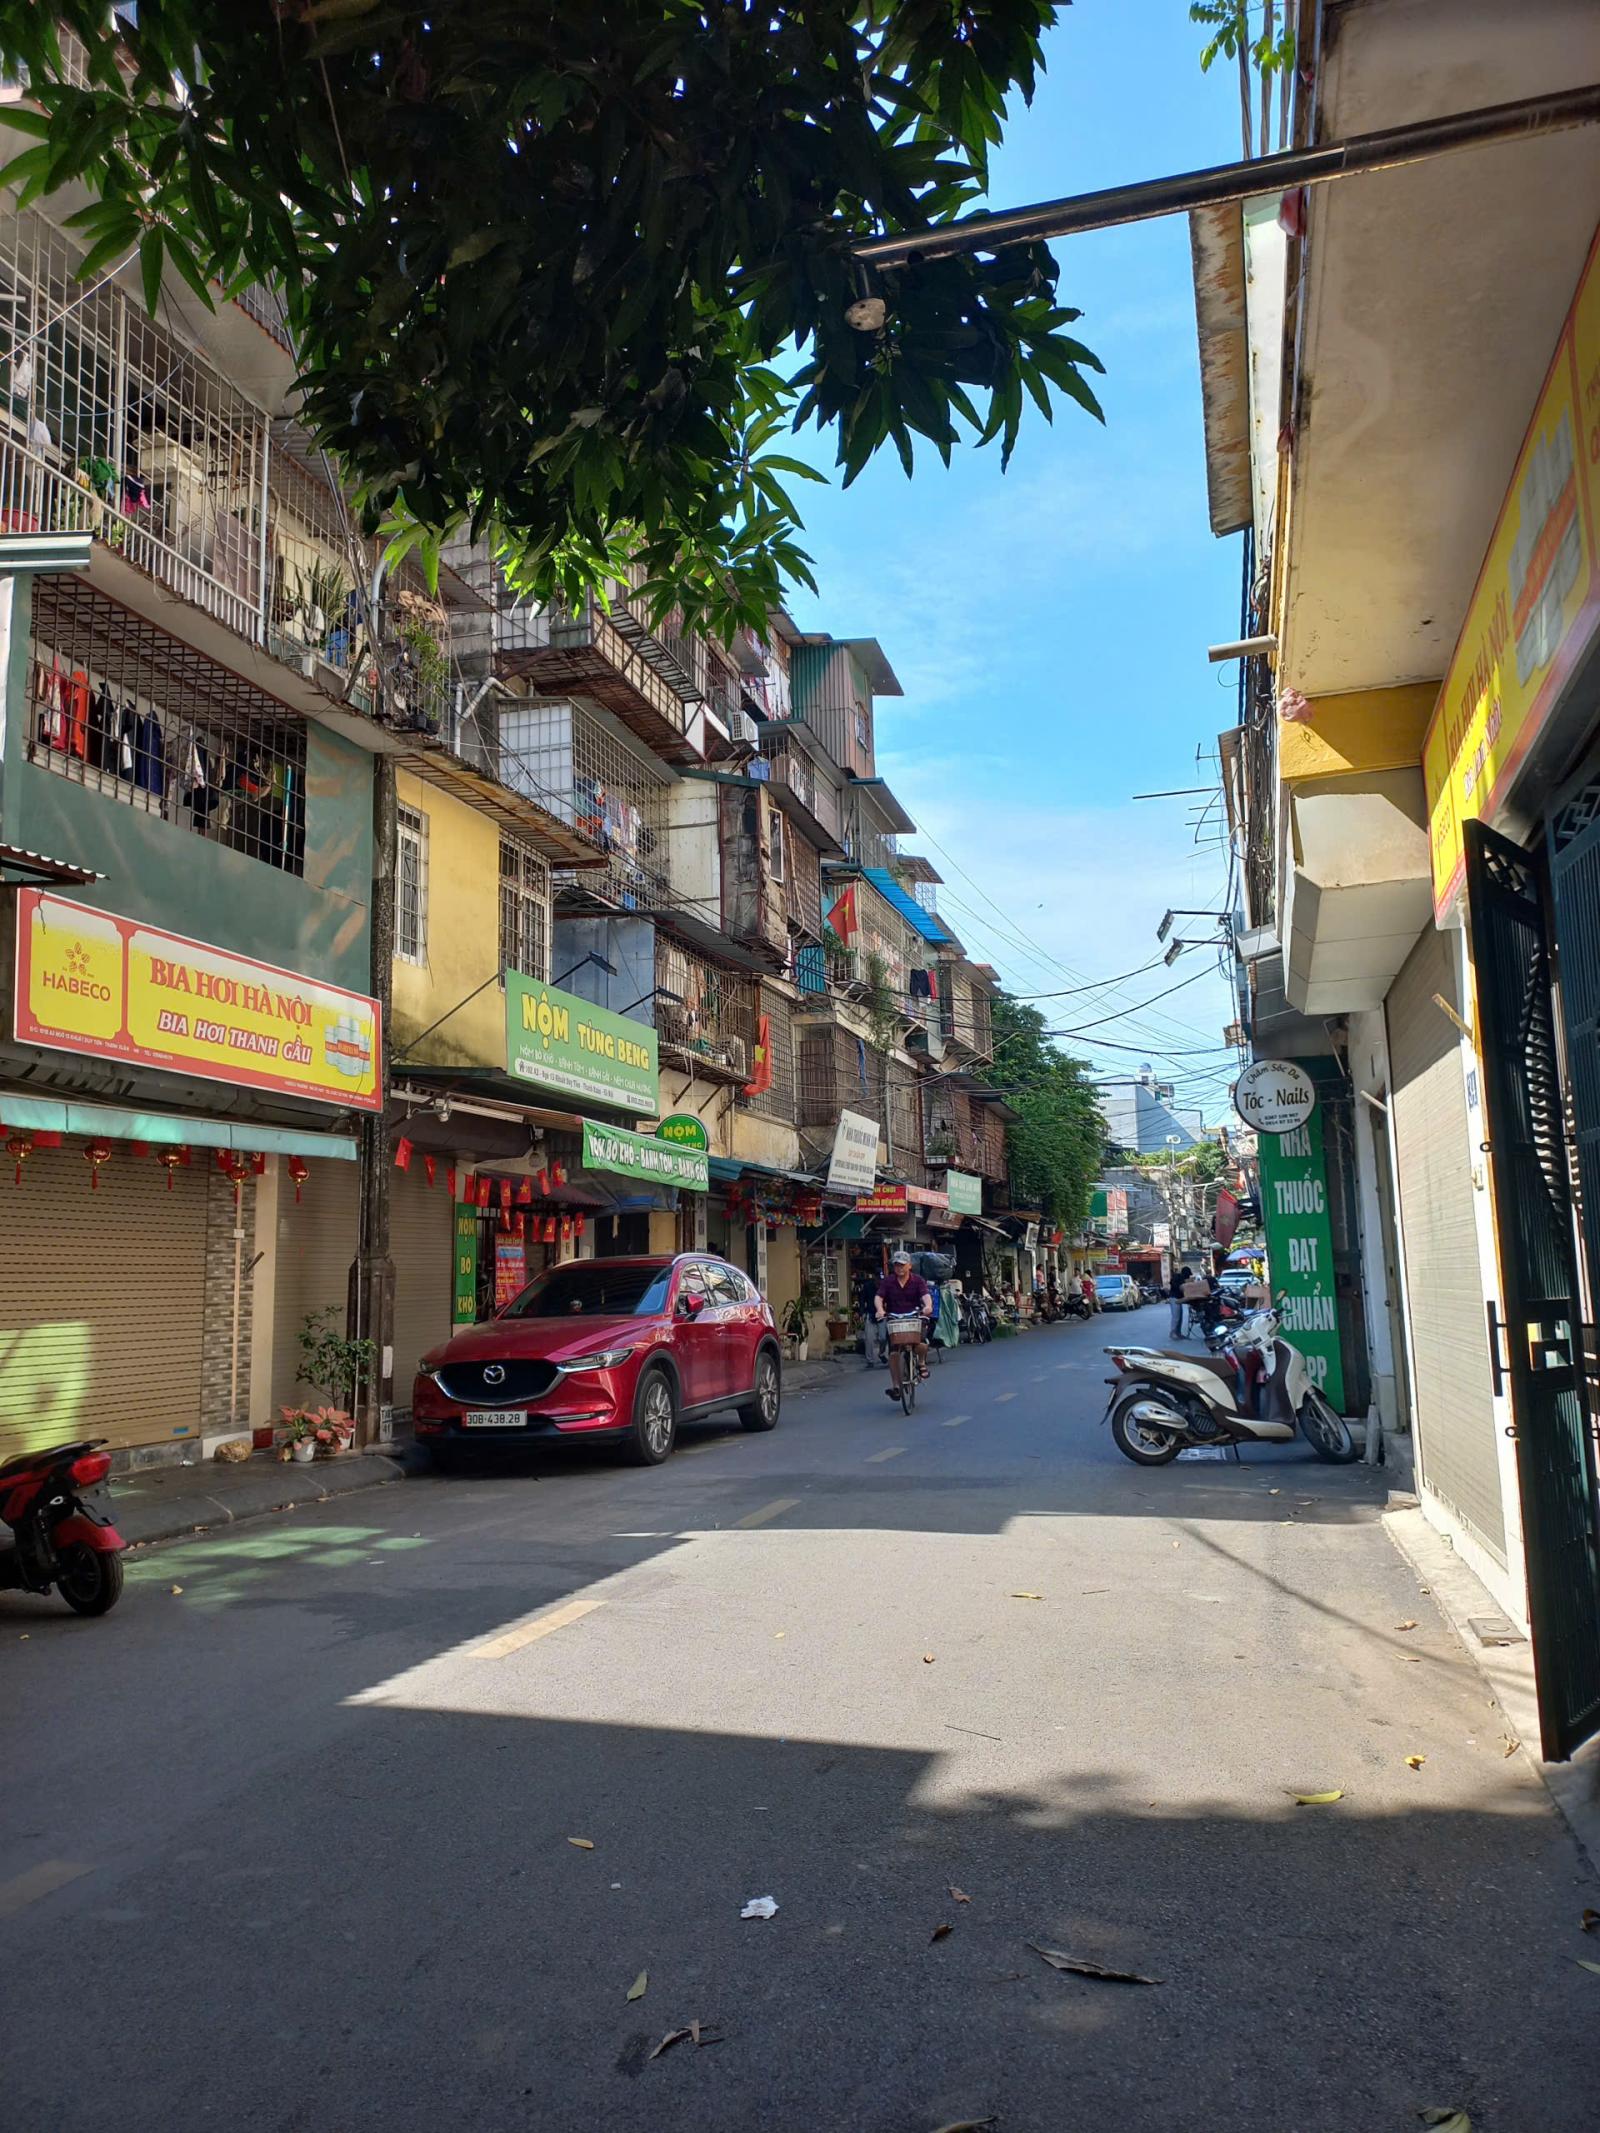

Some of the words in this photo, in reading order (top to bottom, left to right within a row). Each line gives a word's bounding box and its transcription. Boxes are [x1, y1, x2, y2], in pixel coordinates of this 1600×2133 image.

[42, 970, 112, 1002] HABECO
[150, 956, 192, 993] BIA
[195, 970, 239, 1007] HƠI
[242, 984, 273, 1016] HÀ
[276, 995, 313, 1030] NỘI
[158, 1010, 188, 1035] BIA
[195, 1019, 225, 1044] HƠI
[230, 1028, 278, 1056] THANH
[521, 990, 569, 1049] NỘM
[617, 1037, 650, 1071] BENG
[1288, 1068, 1300, 1080] Da
[1243, 1091, 1264, 1110] Tóc
[1276, 1087, 1310, 1107] Nails
[663, 1122, 697, 1141] NỘM
[1274, 1168, 1325, 1214] THUỐC
[1288, 1238, 1318, 1280] ĐẠT
[1281, 1281, 1336, 1331] CHUẨN
[1306, 1356, 1327, 1393] PP
